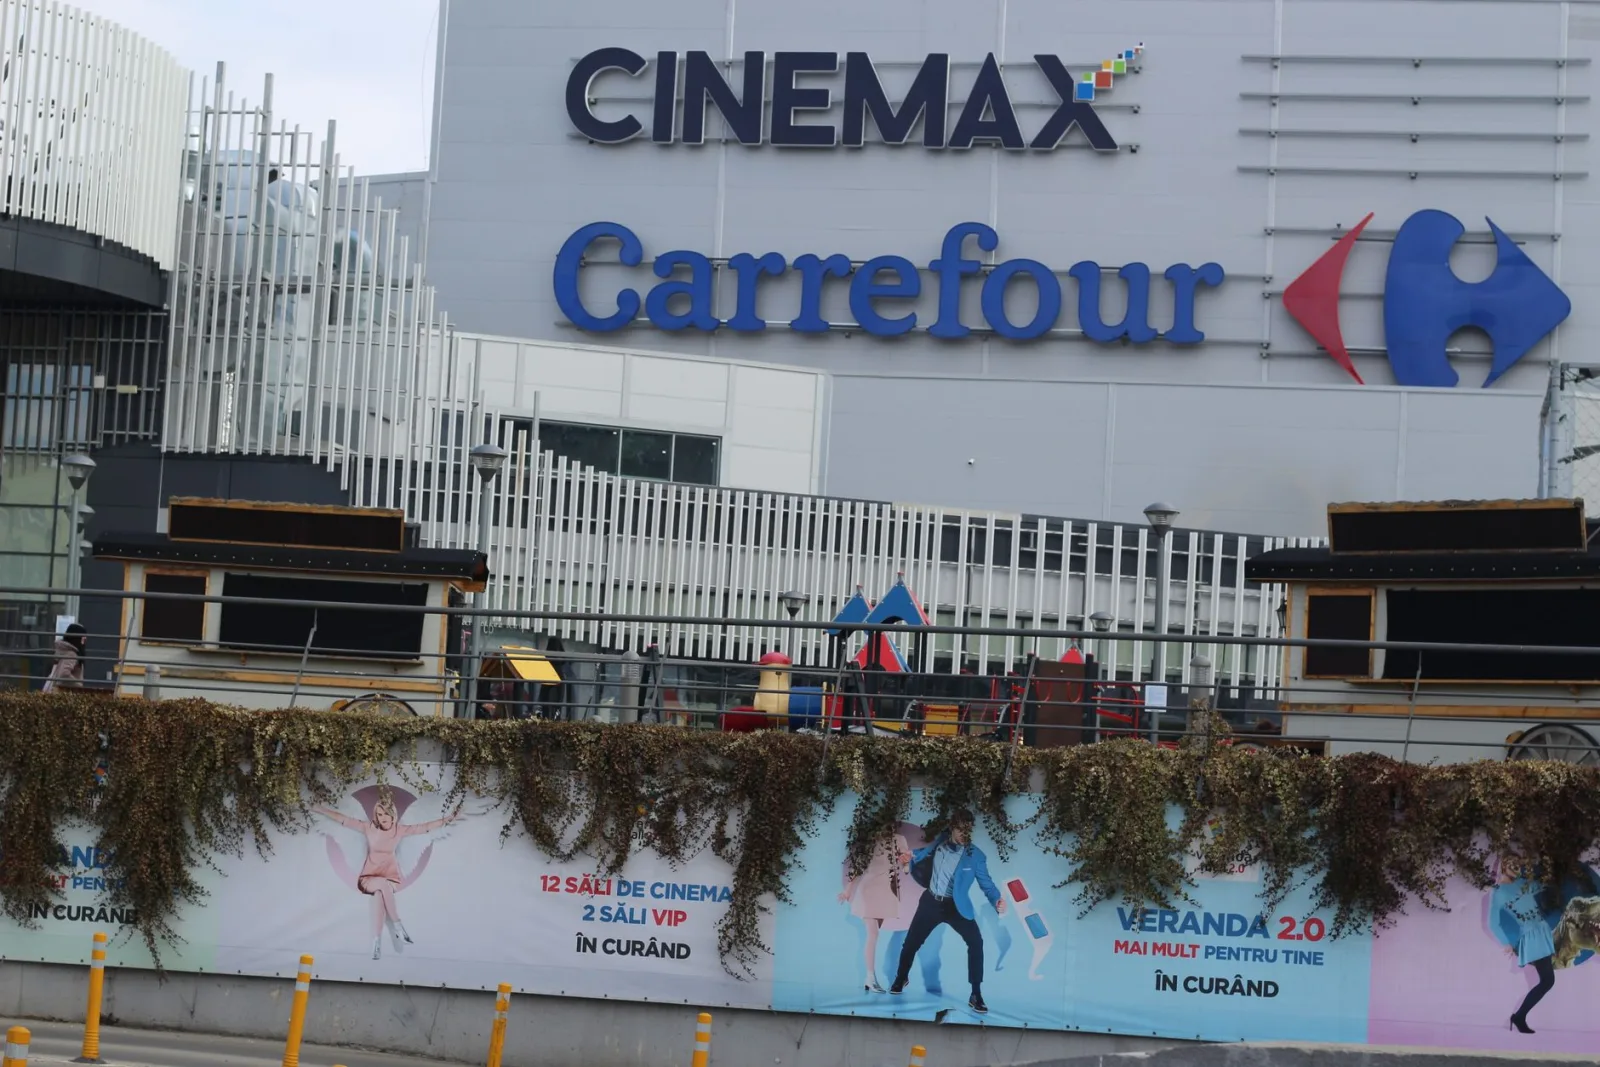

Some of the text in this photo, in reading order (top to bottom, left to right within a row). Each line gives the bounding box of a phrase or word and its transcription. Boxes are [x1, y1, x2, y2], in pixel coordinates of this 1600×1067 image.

[565, 44, 1142, 151] CINEMAX
[553, 221, 1224, 343] Carrefour
[540, 873, 733, 903] 12 SĂLI DE CINEMA
[582, 902, 687, 927] 2 SĂLI VIP
[1117, 907, 1325, 942] VERANDA 2.0
[576, 932, 691, 960] ÎN CURÂND
[1114, 940, 1324, 966] MAI MULT PENTRU TINE
[1155, 969, 1279, 998] ÎN CURÂND
